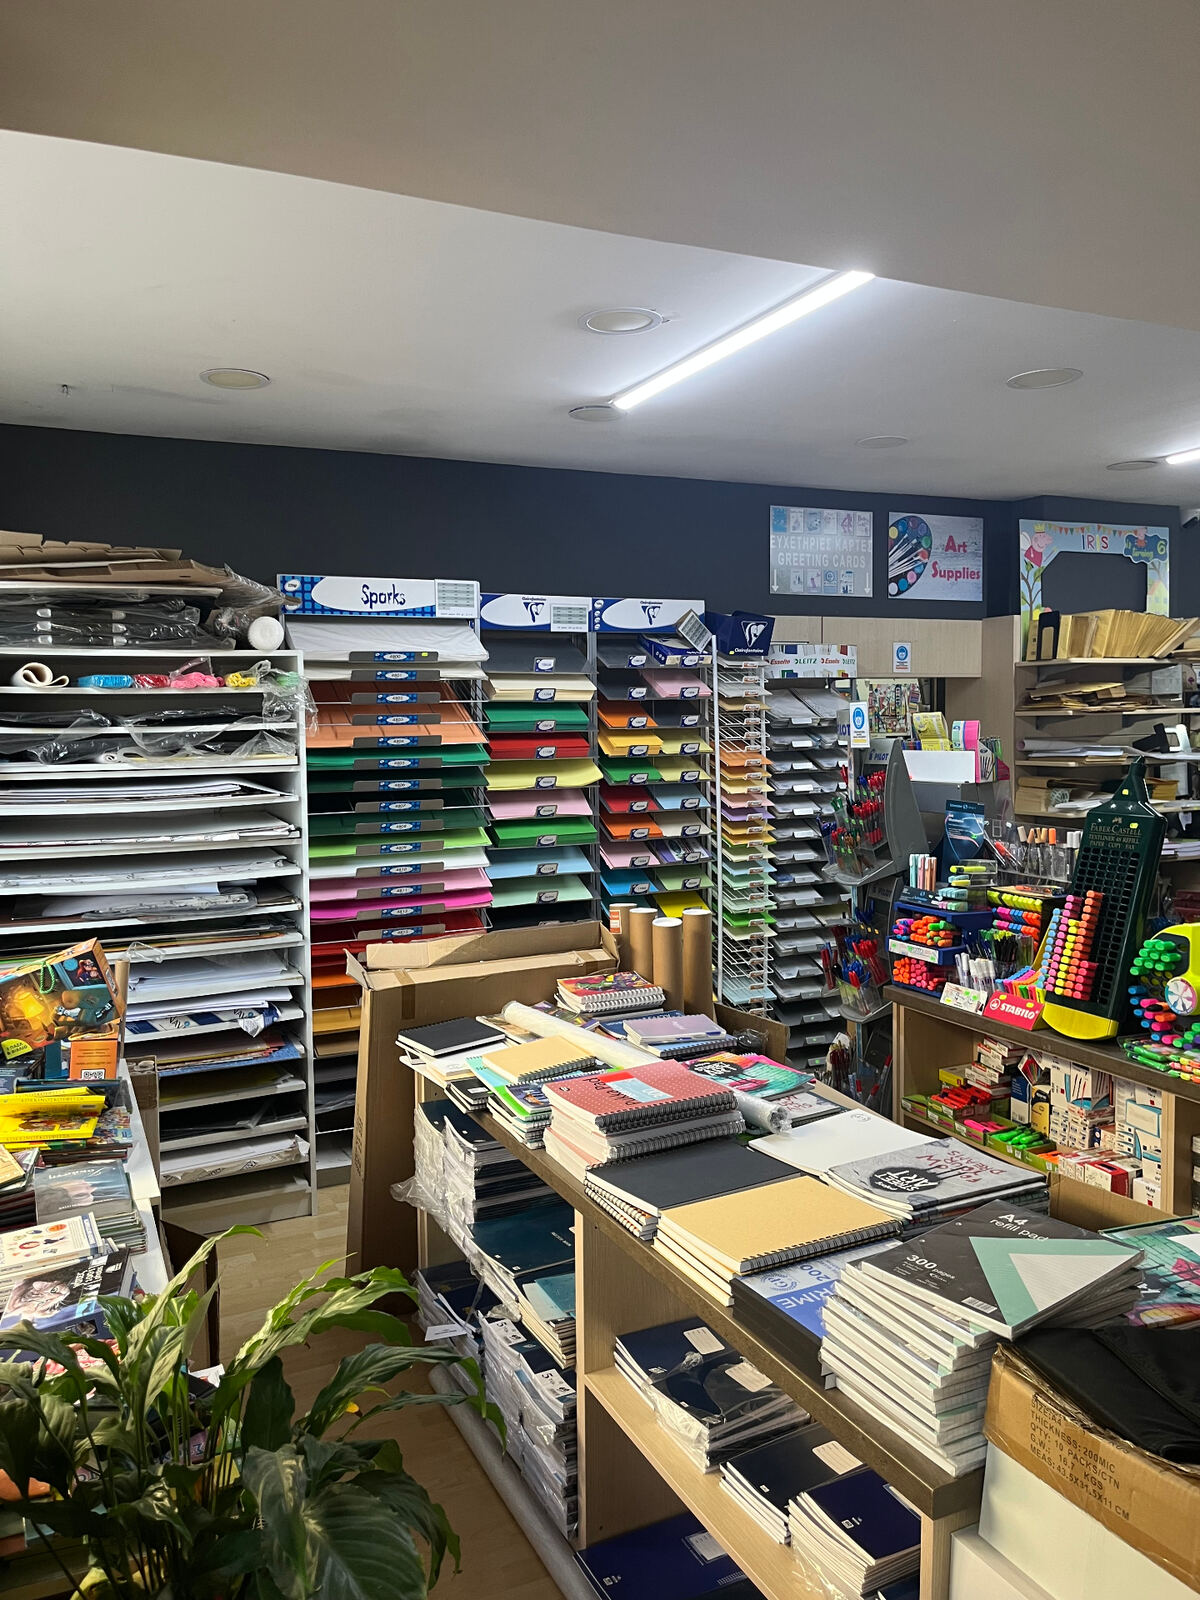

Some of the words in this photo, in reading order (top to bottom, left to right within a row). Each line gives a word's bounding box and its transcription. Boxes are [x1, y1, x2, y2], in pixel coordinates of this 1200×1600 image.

[944, 535, 967, 553] Art
[1081, 534, 1109, 552] IRIS
[1156, 541, 1166, 555] 6
[778, 552, 829, 567] GREETING
[832, 554, 866, 568] CARDS
[932, 560, 981, 581] Supplies
[361, 584, 406, 610] Sparks
[838, 724, 850, 736] LOT
[873, 752, 889, 761] PILOT
[1090, 823, 1141, 835] FABER-CASTELL
[1000, 1003, 1036, 1019] STABILO
[582, 1077, 609, 1090] Pad
[874, 1173, 920, 1192] STREET
[886, 1170, 938, 1187] ART
[999, 1213, 1029, 1225] A4
[990, 1219, 1020, 1232] refill
[1018, 1229, 1049, 1241] pad
[906, 1254, 937, 1269] 300
[799, 1264, 831, 1282] 200
[776, 1287, 835, 1309] RIME
[1055, 1440, 1064, 1452] 10
[1067, 1449, 1120, 1489] PACKS/CTN
[1083, 1471, 1104, 1491] KGS
